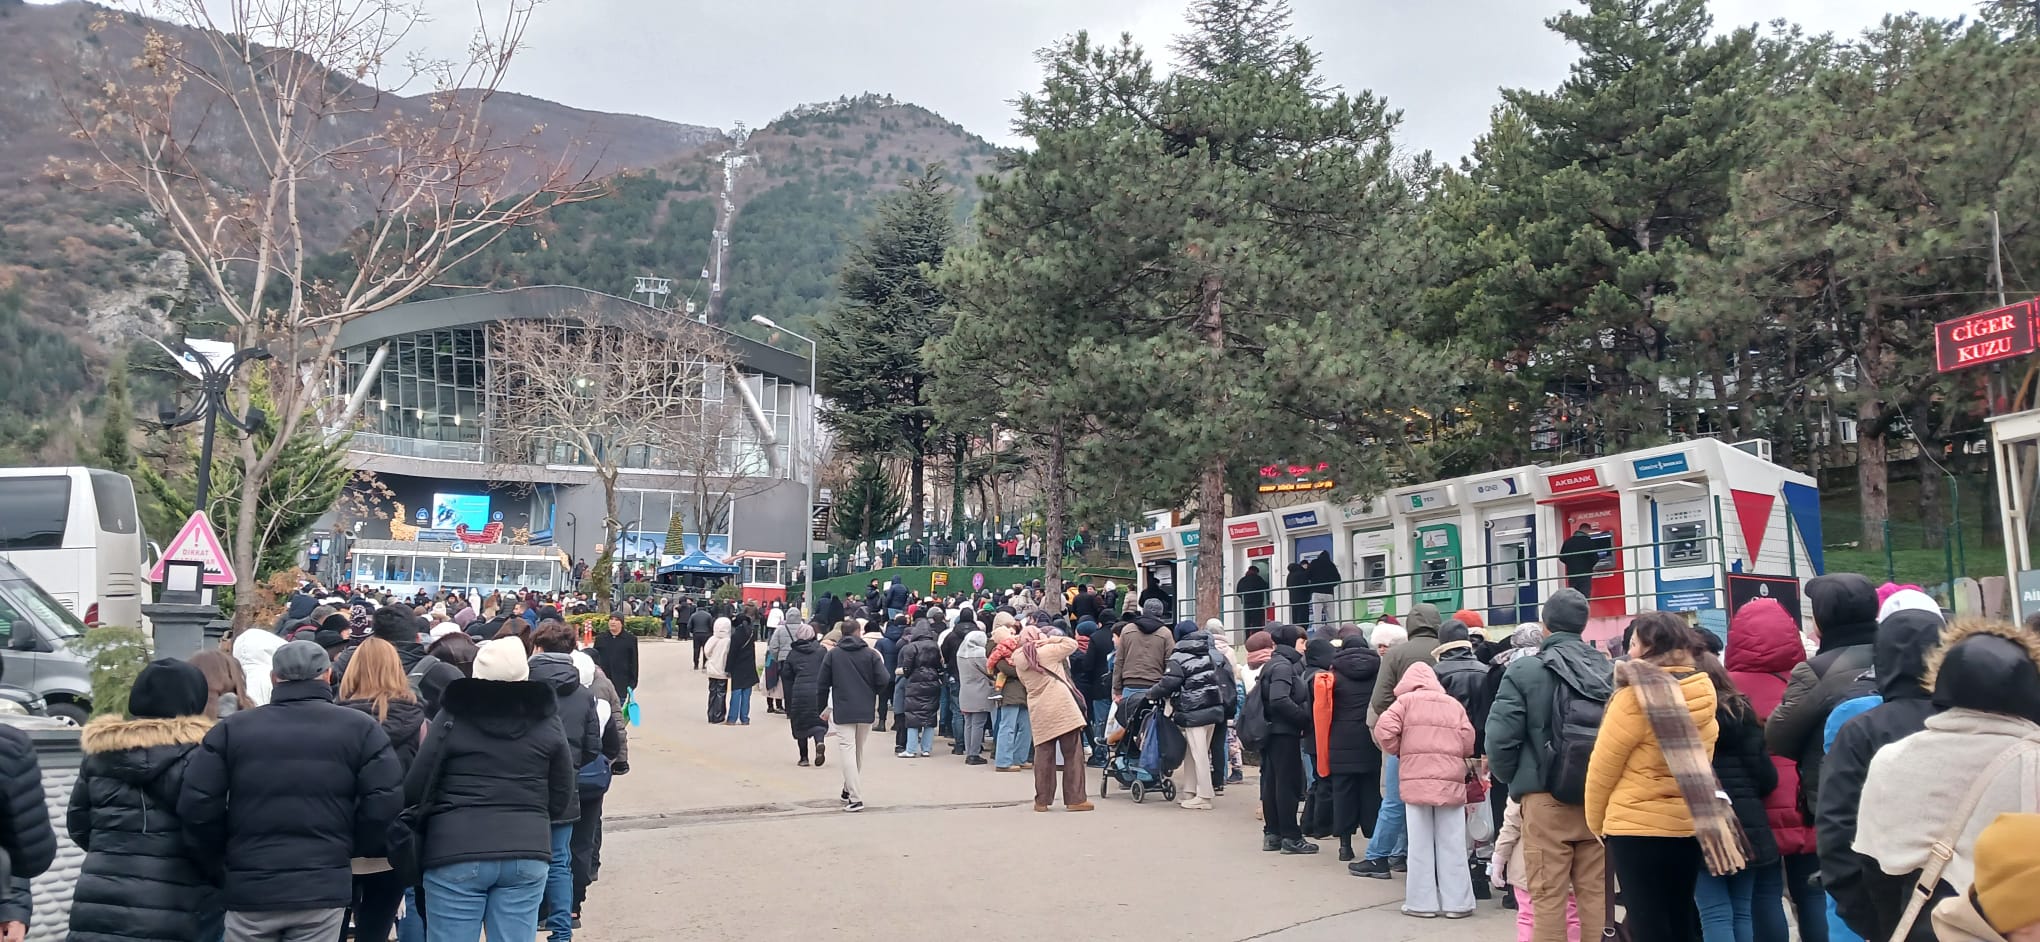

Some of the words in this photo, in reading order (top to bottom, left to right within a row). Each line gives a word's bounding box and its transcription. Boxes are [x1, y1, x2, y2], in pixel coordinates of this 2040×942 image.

[1952, 314, 2016, 342] CİĞER
[1957, 336, 2012, 362] KUZU
[1555, 474, 1592, 487] AKBANK
[1484, 484, 1498, 492] QNB
[1577, 510, 1612, 520] AKBANK
